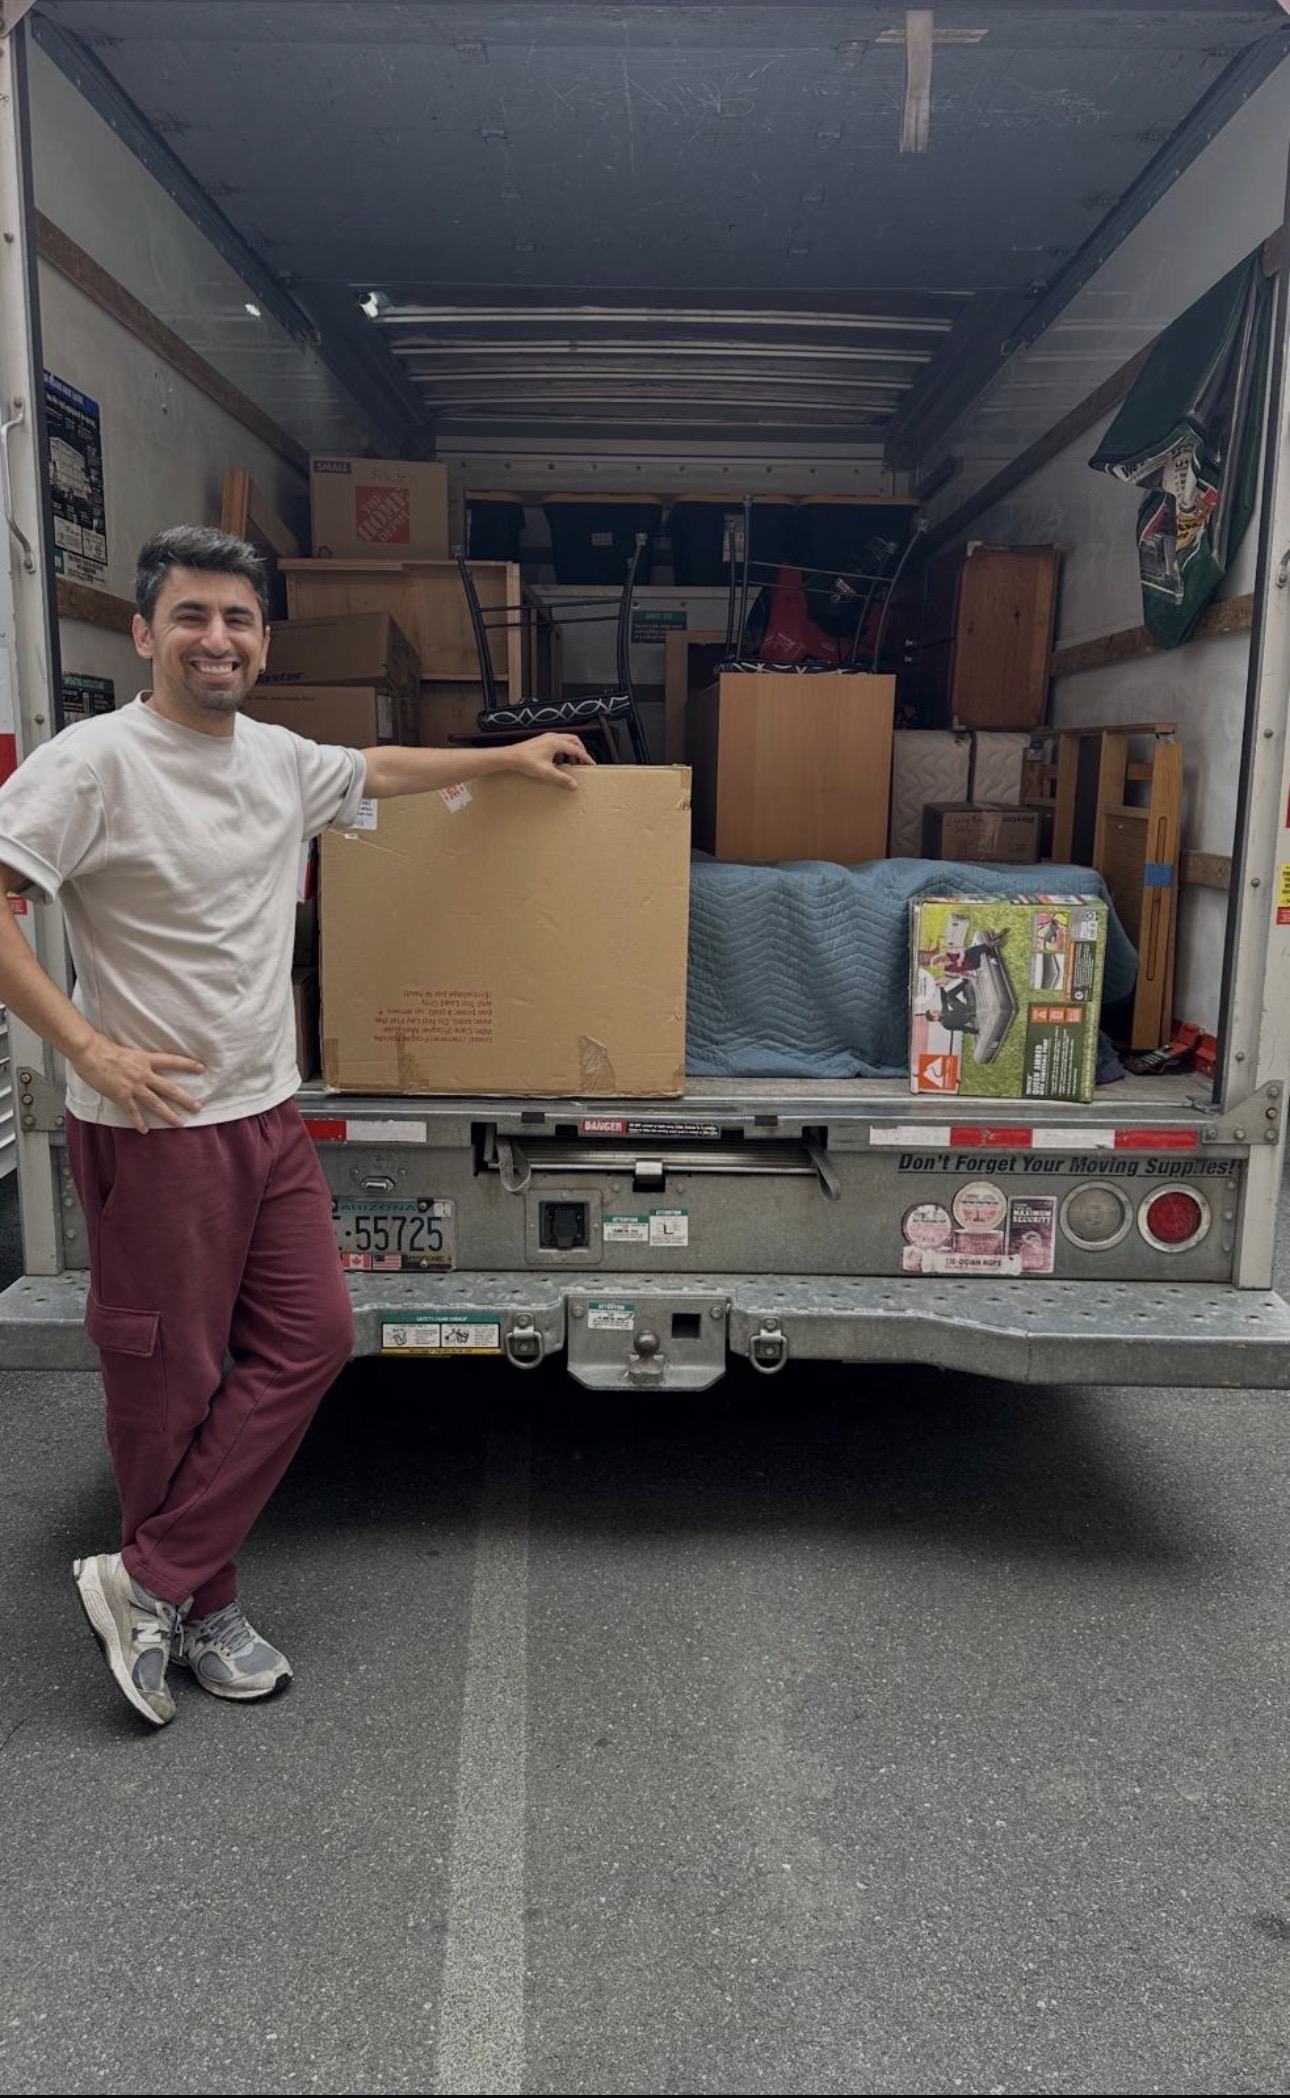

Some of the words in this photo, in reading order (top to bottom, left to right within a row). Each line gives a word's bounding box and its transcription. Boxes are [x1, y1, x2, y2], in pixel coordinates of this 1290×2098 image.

[316, 462, 348, 472] SMALL
[357, 489, 410, 542] HOME
[379, 511, 410, 542] DEPOT
[258, 671, 305, 683] axter
[584, 1121, 622, 1131] DANGER
[899, 1153, 950, 1171] Don't
[954, 1154, 1016, 1174] Forget
[1022, 1155, 1062, 1172] Your
[1068, 1157, 1138, 1177] Moving
[340, 1203, 416, 1212] ARIZONA
